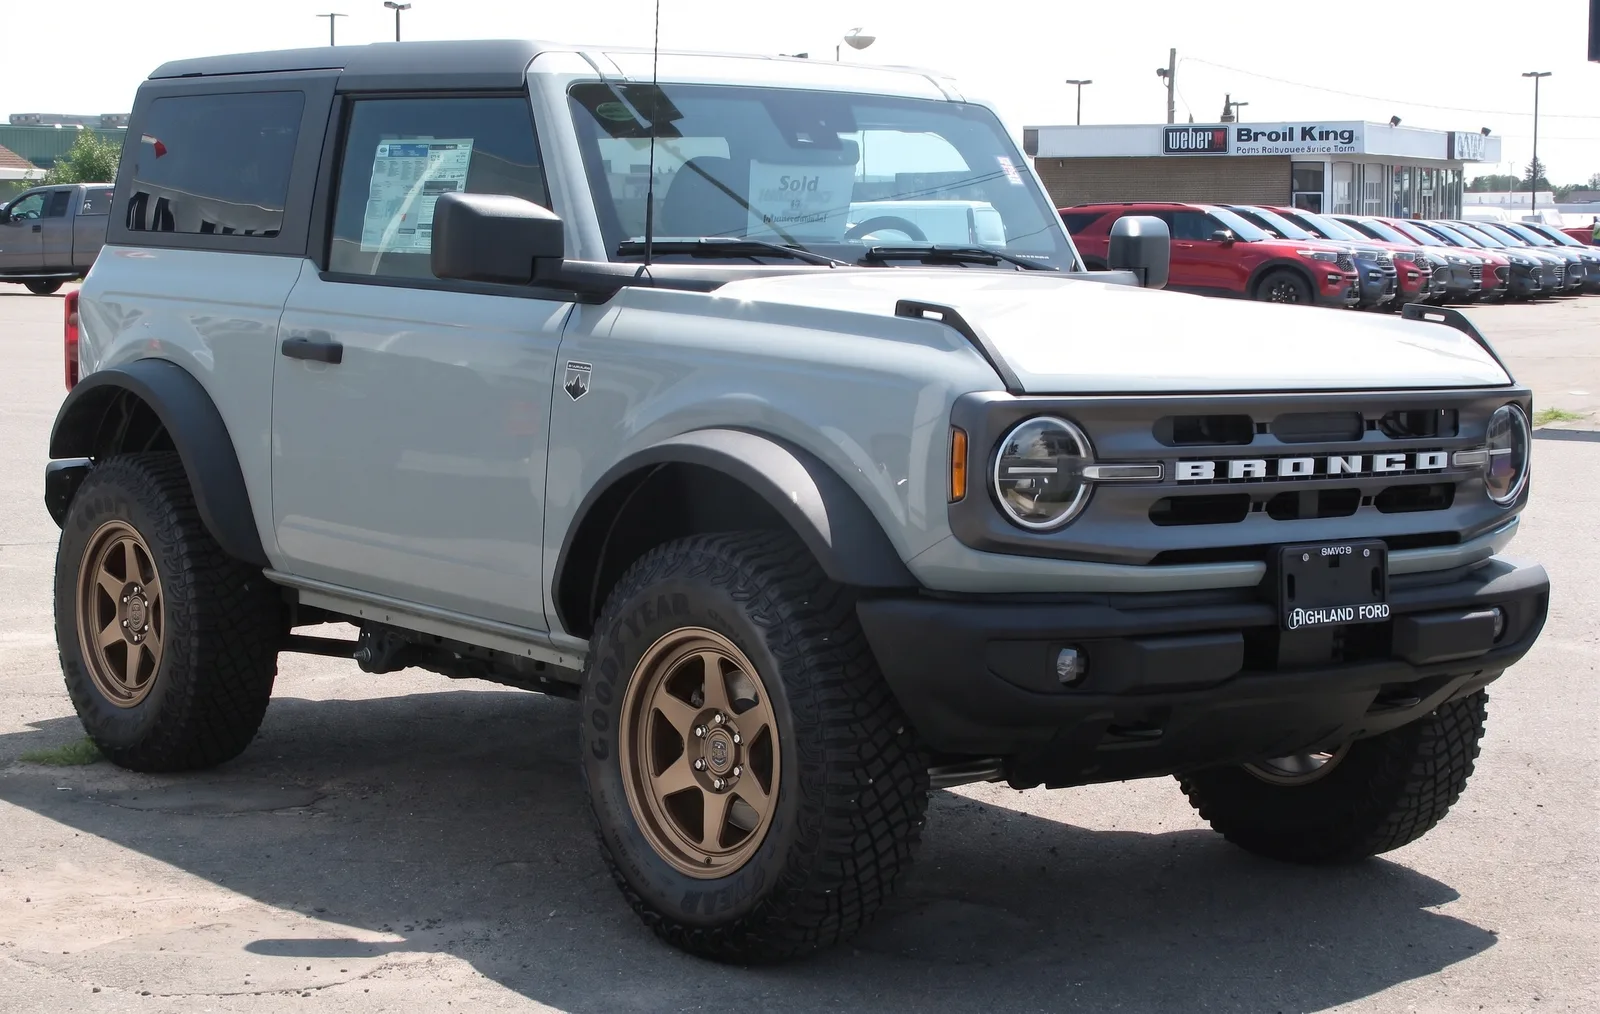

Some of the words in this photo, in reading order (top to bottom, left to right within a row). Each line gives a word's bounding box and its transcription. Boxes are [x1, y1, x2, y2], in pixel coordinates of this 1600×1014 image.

[1168, 128, 1212, 149] weber
[1236, 127, 1294, 142] Broil
[1301, 126, 1354, 145] King
[779, 175, 819, 192] Sold
[1175, 451, 1448, 481] BRONCO
[1289, 608, 1354, 629] HIGHLAND
[1359, 604, 1390, 619] FORD
